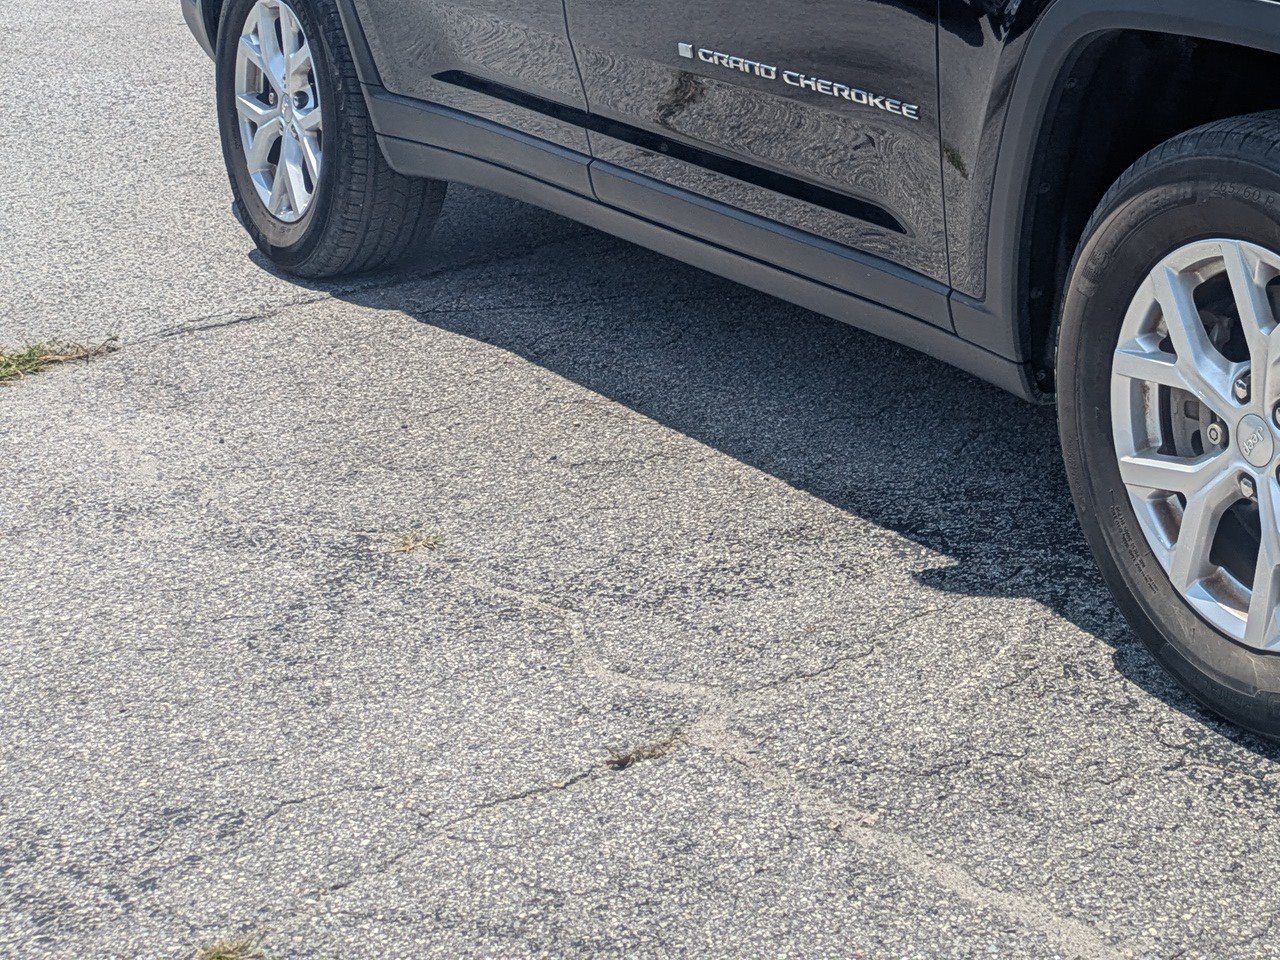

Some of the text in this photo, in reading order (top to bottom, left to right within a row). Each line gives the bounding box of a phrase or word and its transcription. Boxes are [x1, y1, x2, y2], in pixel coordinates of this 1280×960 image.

[697, 48, 920, 121] GRAND CHEROKEE
[1212, 181, 1262, 203] 265/60
[1264, 193, 1275, 208] R
[1242, 426, 1264, 456] Jeep
